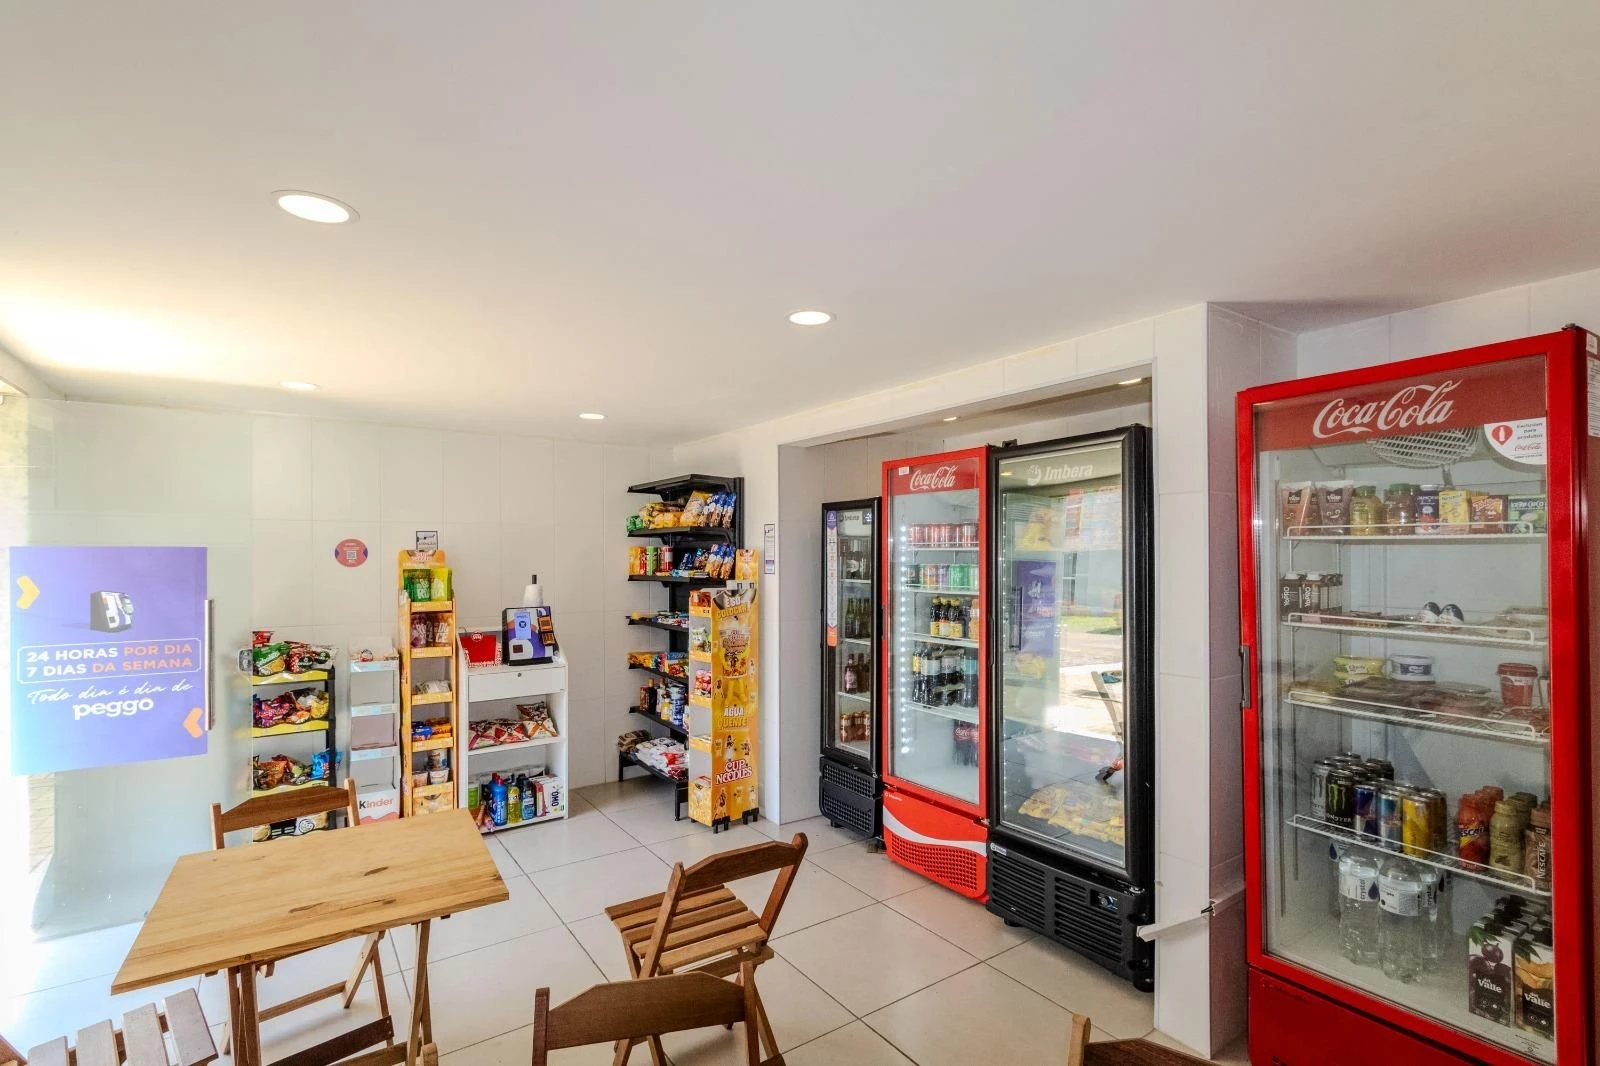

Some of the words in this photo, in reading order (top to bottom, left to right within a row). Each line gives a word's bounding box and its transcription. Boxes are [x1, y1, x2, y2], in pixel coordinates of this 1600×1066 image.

[1312, 379, 1464, 439] Coca-Cola
[910, 465, 959, 491] Coca-Cola
[1044, 463, 1094, 481] Imbera
[26, 650, 49, 663] 24
[55, 648, 118, 661] HORAS
[124, 645, 159, 656] POR
[164, 643, 193, 655] DIA
[27, 666, 38, 678] 7
[43, 664, 87, 677] DIAS
[92, 662, 116, 673] DA
[122, 657, 193, 672] SEMANA
[27, 687, 72, 705] Todo
[78, 684, 113, 698] dia
[133, 680, 166, 695] dia
[171, 678, 193, 692] de
[72, 698, 154, 720] peggo
[725, 759, 746, 772] CUP
[715, 767, 752, 785] NOODLES
[359, 798, 394, 810] Kinder
[551, 791, 560, 807] OMO
[1478, 979, 1503, 993] Valle
[1524, 992, 1552, 1008] Valle
